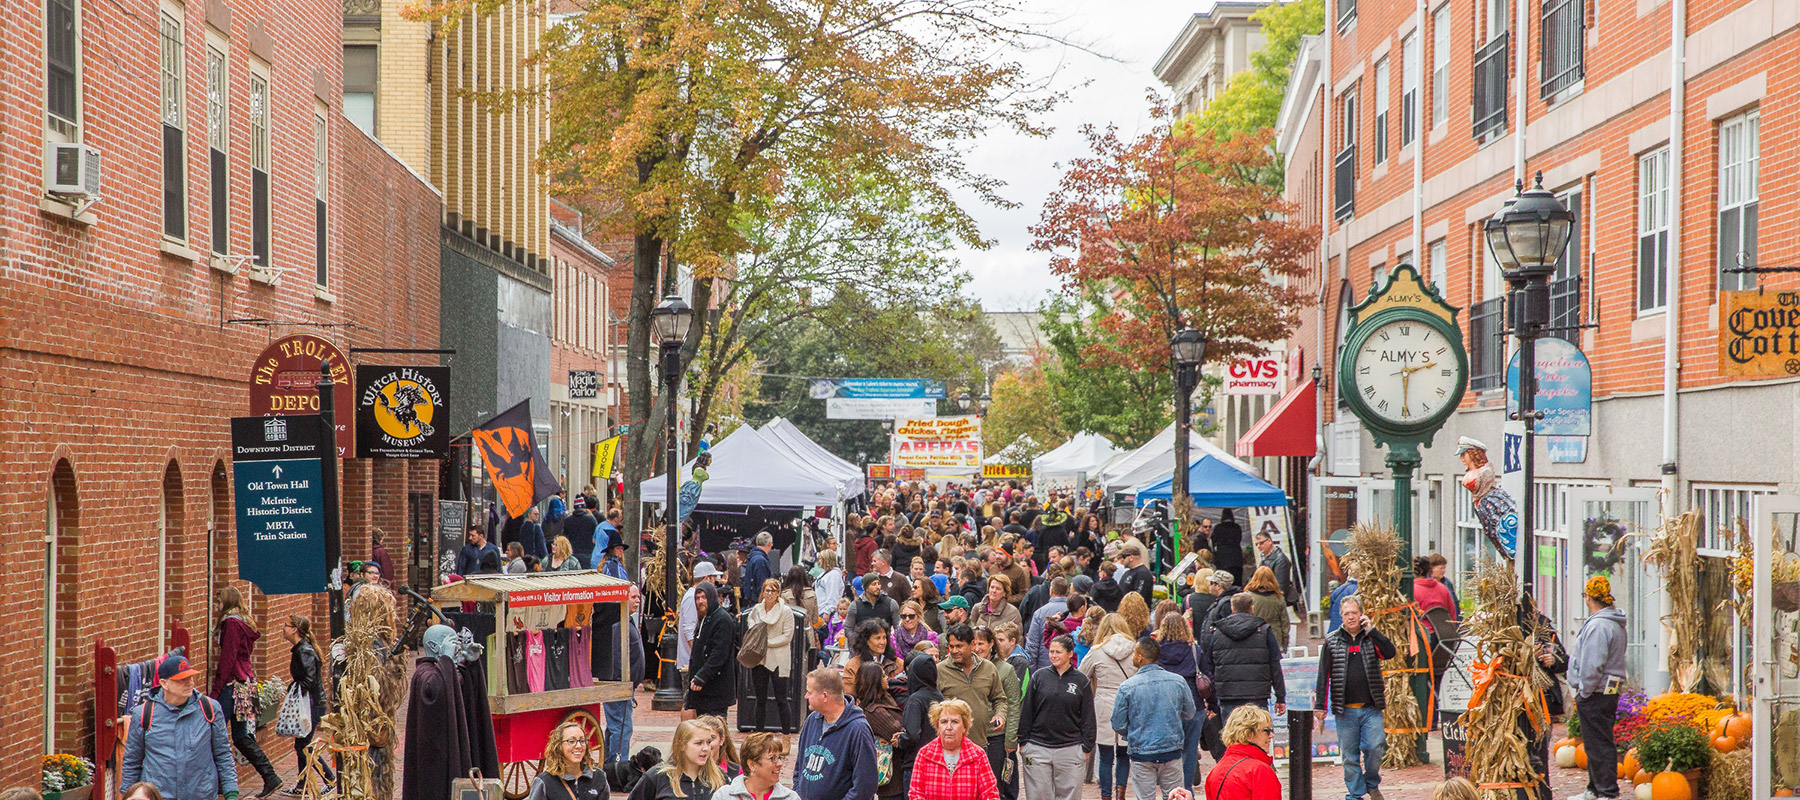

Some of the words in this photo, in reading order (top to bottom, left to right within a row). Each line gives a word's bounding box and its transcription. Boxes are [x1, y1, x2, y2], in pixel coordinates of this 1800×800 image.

[1386, 294, 1422, 303] ALMY'S
[1777, 291, 1800, 307] Th
[1728, 307, 1800, 336] Cove
[1728, 331, 1799, 364] Cott
[256, 357, 279, 386] The
[280, 339, 349, 386] TROLLEY
[1380, 350, 1430, 363] ALMY'S
[1229, 360, 1278, 379] CVS
[1513, 357, 1586, 370] ngelica
[569, 374, 596, 389] Magic
[1229, 380, 1277, 389] pharmacy
[270, 394, 321, 411] DEPO
[907, 419, 933, 427] Fried
[936, 418, 969, 428] Dough
[898, 427, 937, 435] Chicken
[940, 426, 979, 435] Fingers
[381, 433, 426, 448] MUSEUM
[899, 441, 978, 453] AREPAS
[599, 443, 609, 477] BOOKS
[247, 482, 264, 491] Old
[265, 481, 289, 490] Town
[290, 480, 309, 489] Hall
[261, 497, 297, 505] McIntire
[247, 507, 280, 516] Historic
[281, 506, 312, 515] District
[266, 521, 295, 530] MBTA
[254, 532, 277, 541] Train
[278, 531, 307, 540] Station
[543, 591, 561, 602] Visitor
[562, 590, 594, 601] Information
